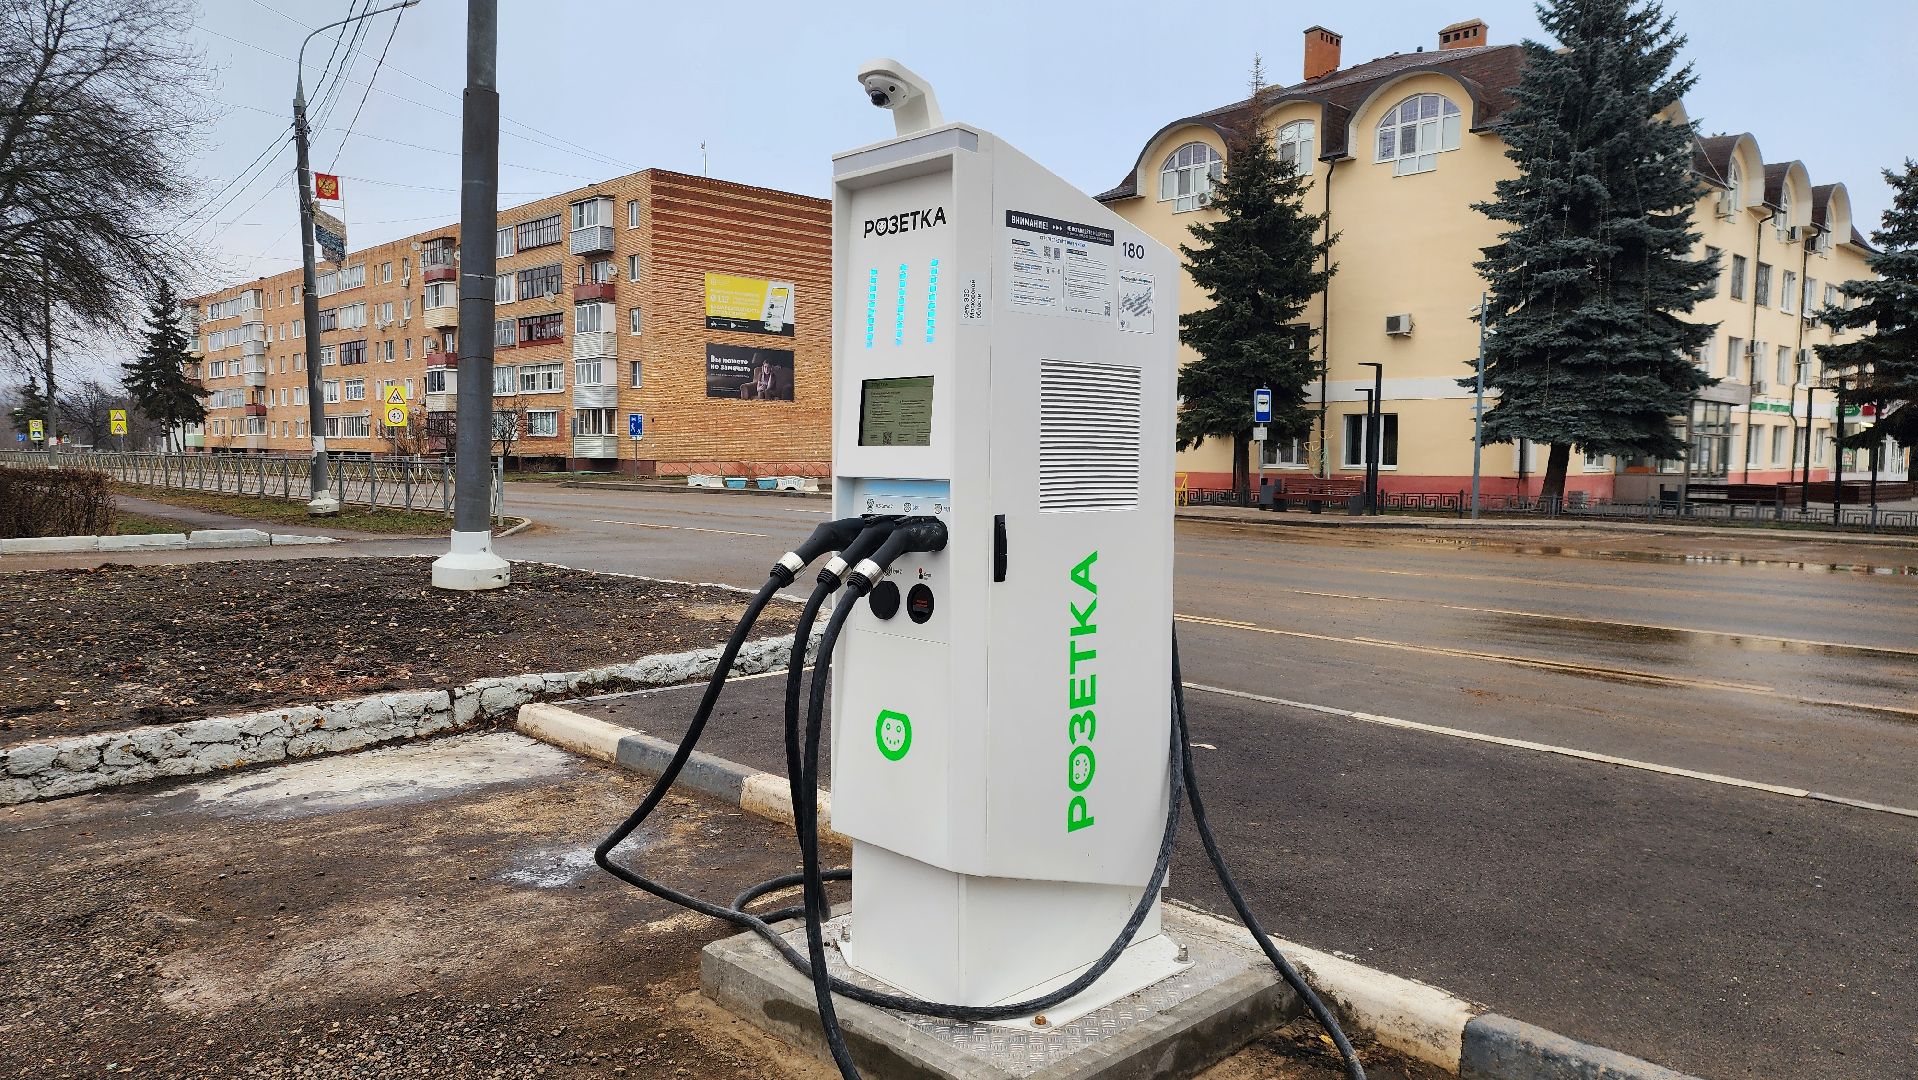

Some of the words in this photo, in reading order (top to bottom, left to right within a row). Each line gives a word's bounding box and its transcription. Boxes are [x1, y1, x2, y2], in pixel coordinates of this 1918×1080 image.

[863, 206, 947, 239] РОЗЕТКА
[1122, 241, 1145, 260] 180
[1067, 550, 1098, 834] РОЗЕТКА
